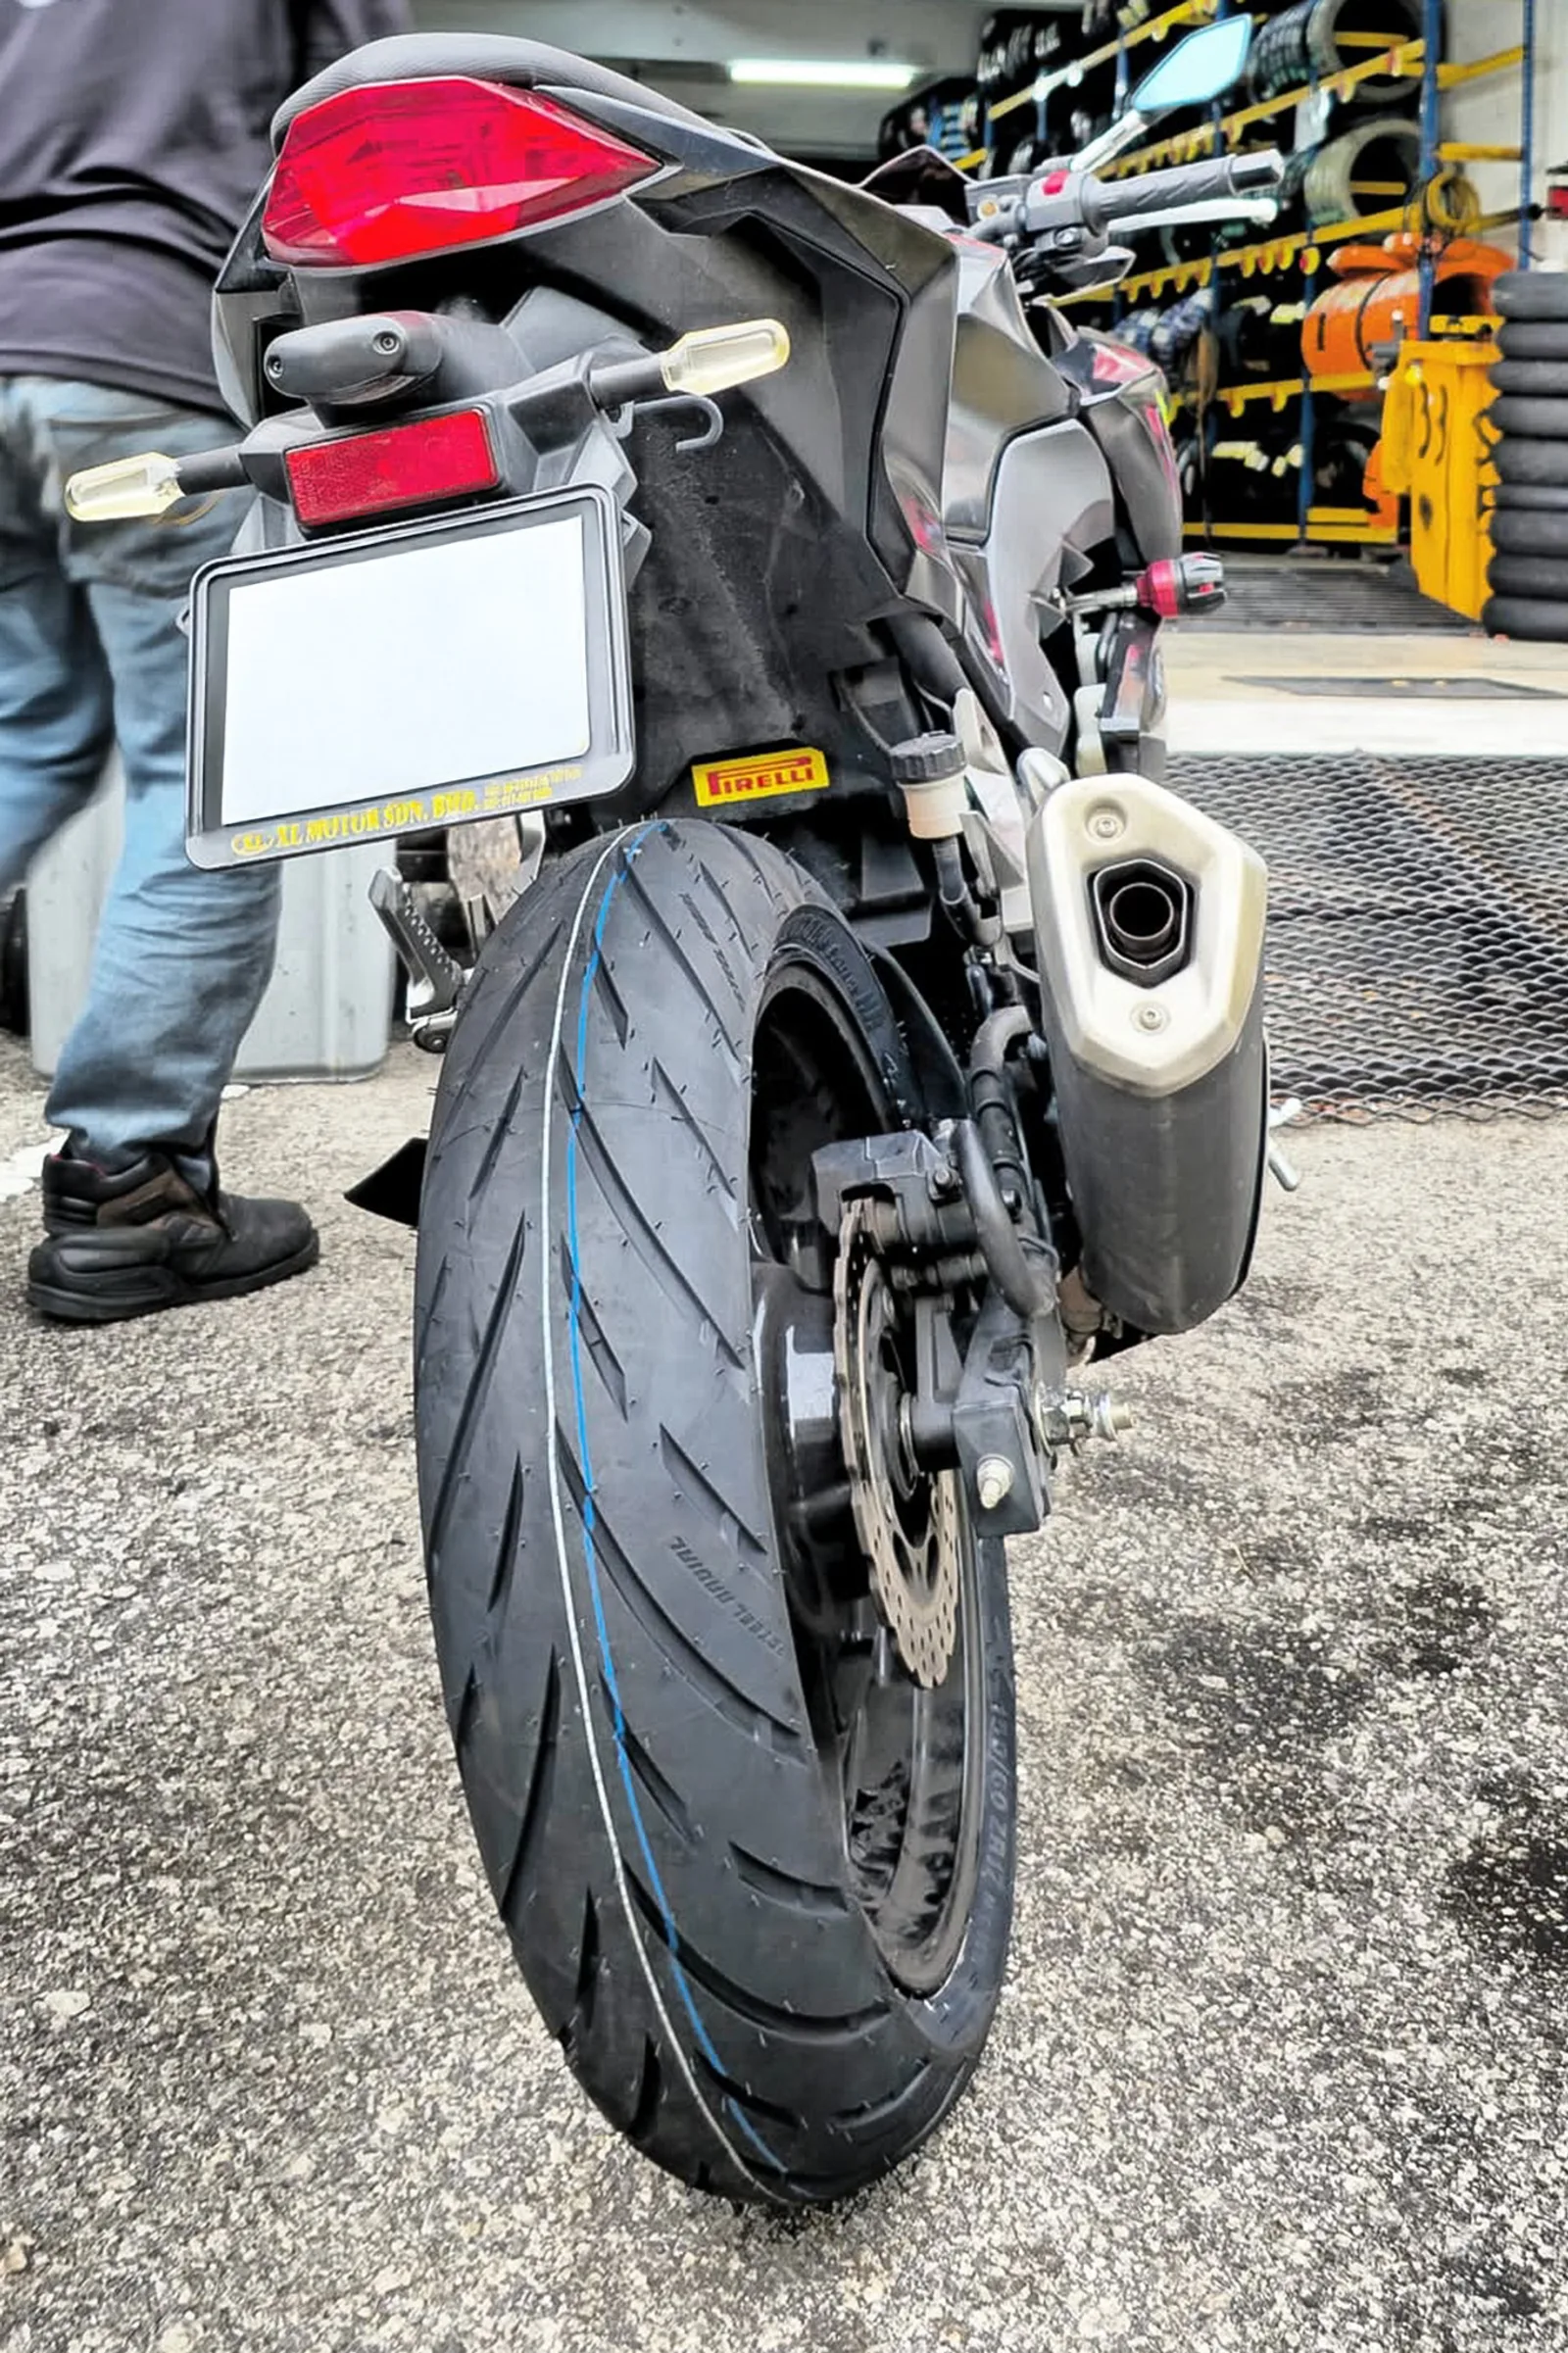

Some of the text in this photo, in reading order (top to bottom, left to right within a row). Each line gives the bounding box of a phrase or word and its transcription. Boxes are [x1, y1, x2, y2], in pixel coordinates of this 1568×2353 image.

[707, 757, 813, 796] PIRELLI
[306, 808, 379, 843] MOTOR
[669, 1535, 736, 1604] RADIAL
